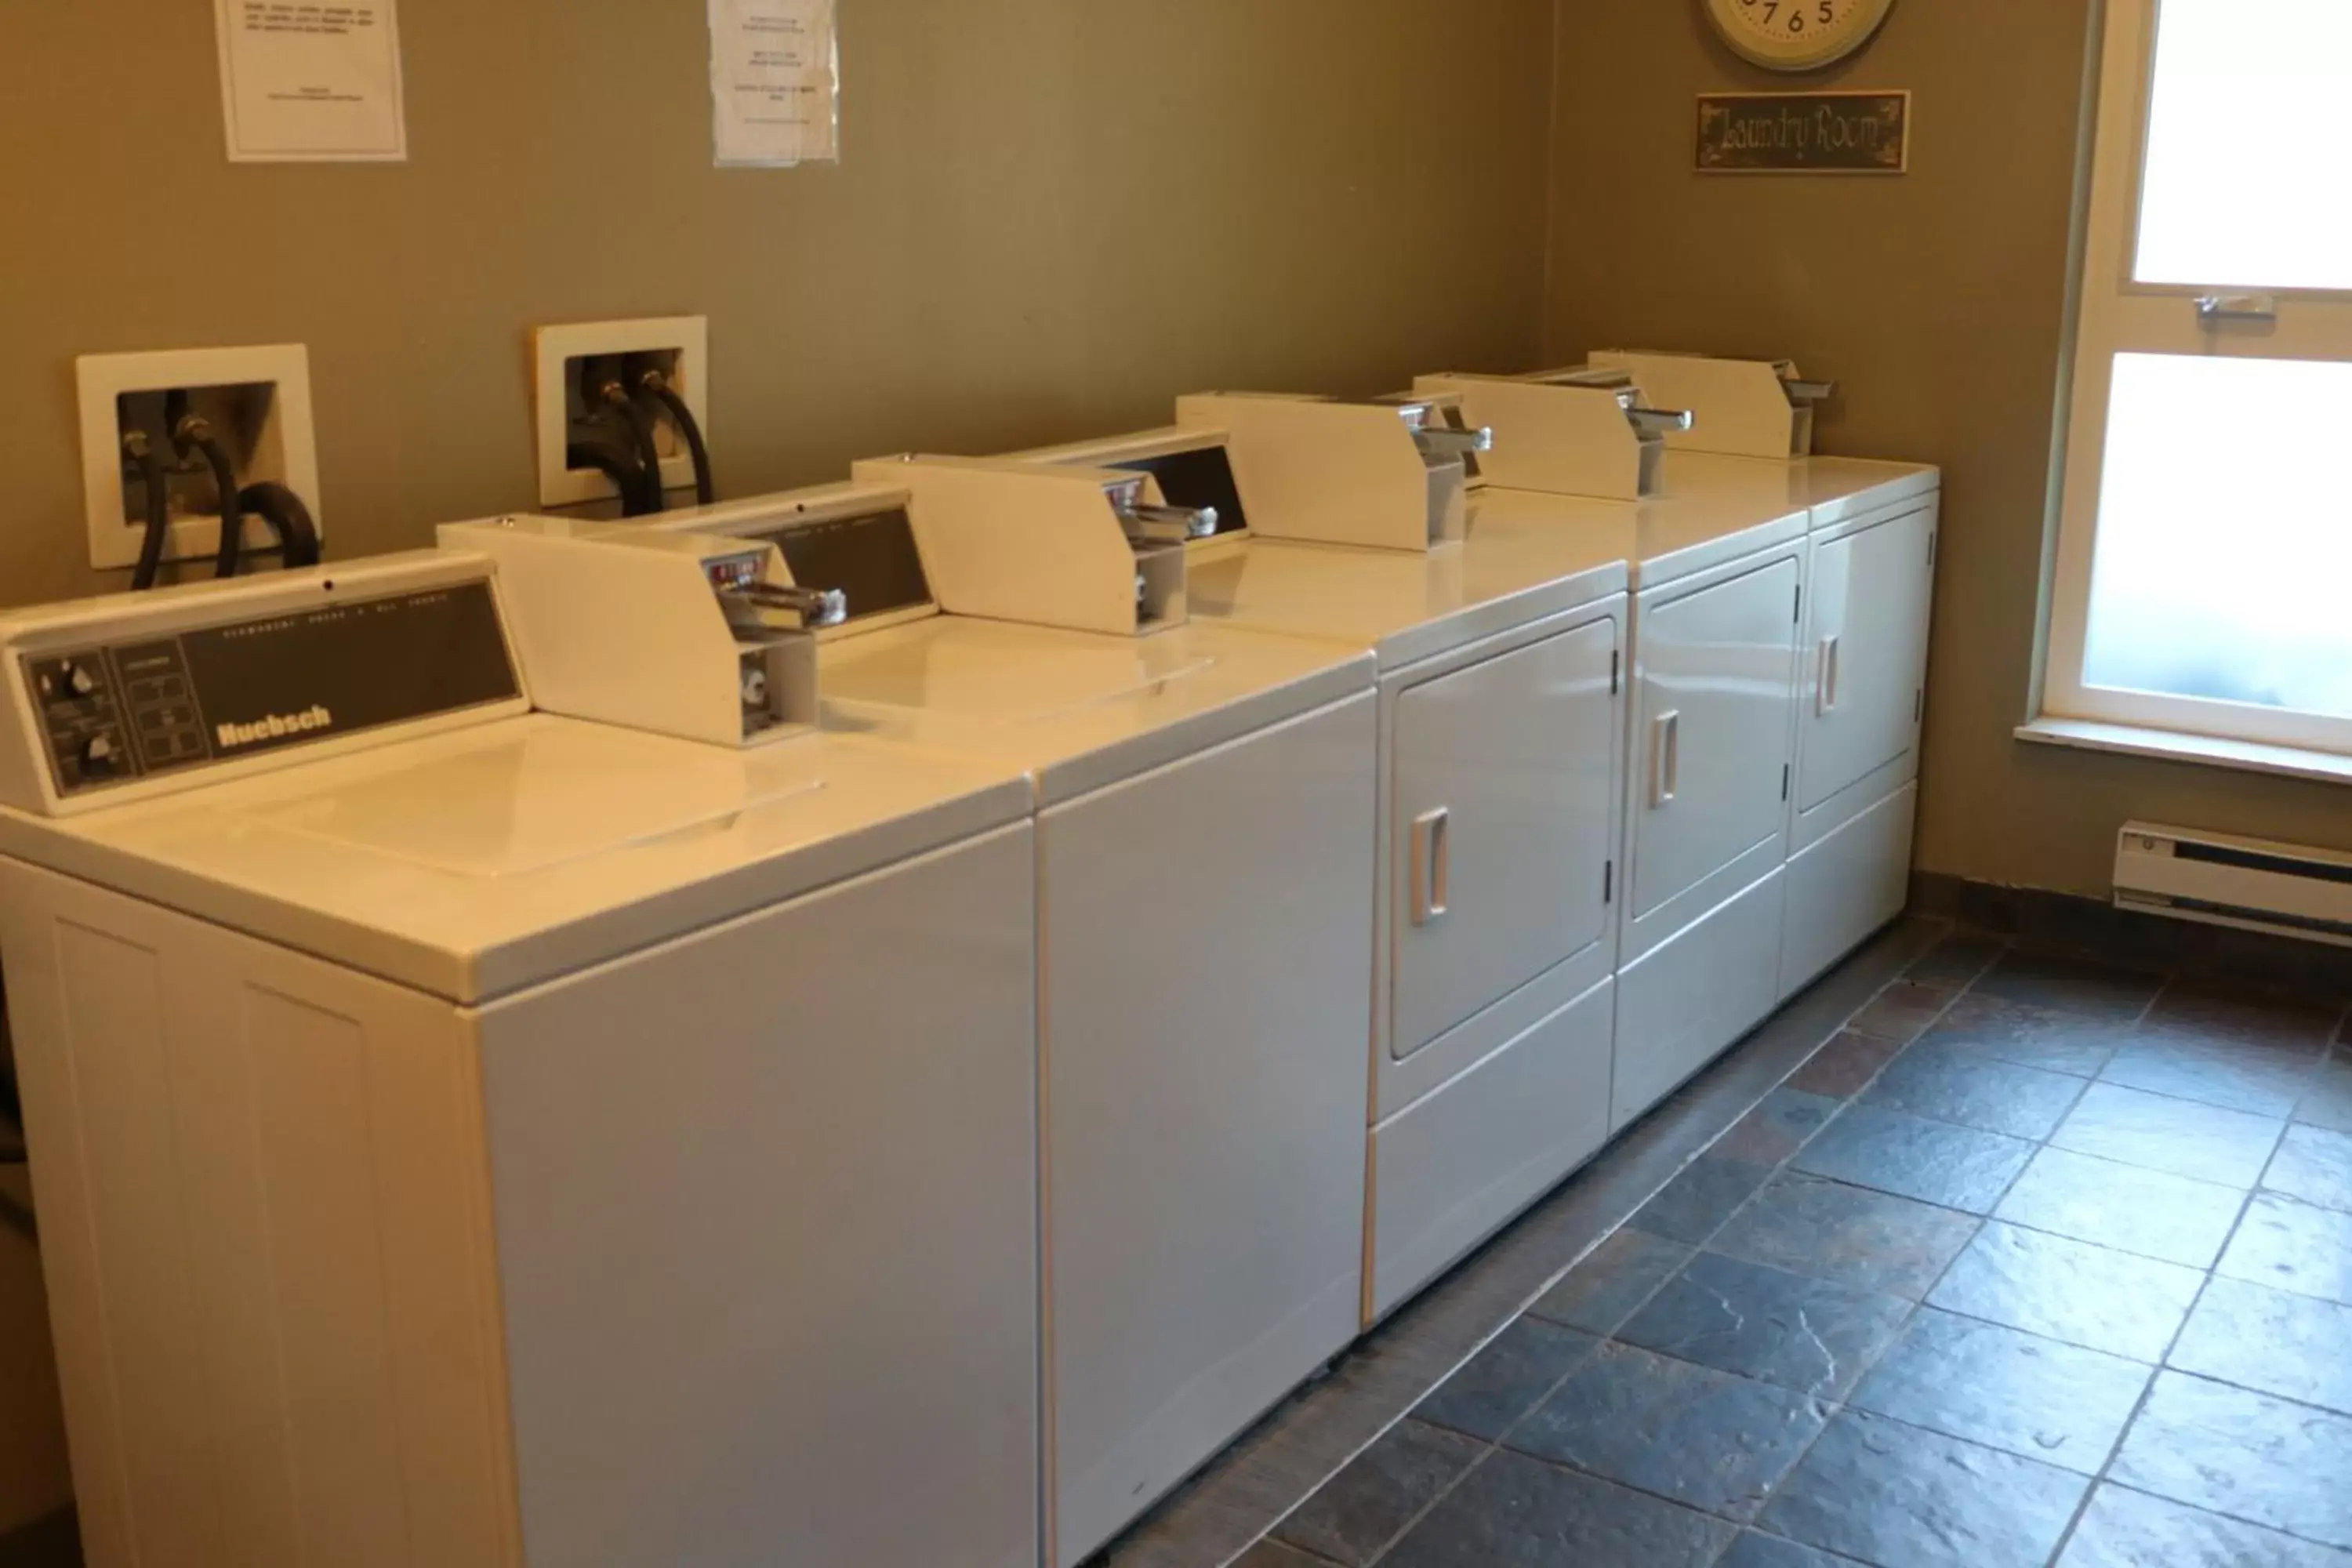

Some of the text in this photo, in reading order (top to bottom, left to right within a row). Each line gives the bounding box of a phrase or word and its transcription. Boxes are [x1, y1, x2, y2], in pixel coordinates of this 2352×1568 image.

[1763, 2, 1778, 24] 7
[1788, 9, 1804, 33] 6
[1818, 1, 1832, 24] 5
[1721, 104, 1879, 161] Laundry Room
